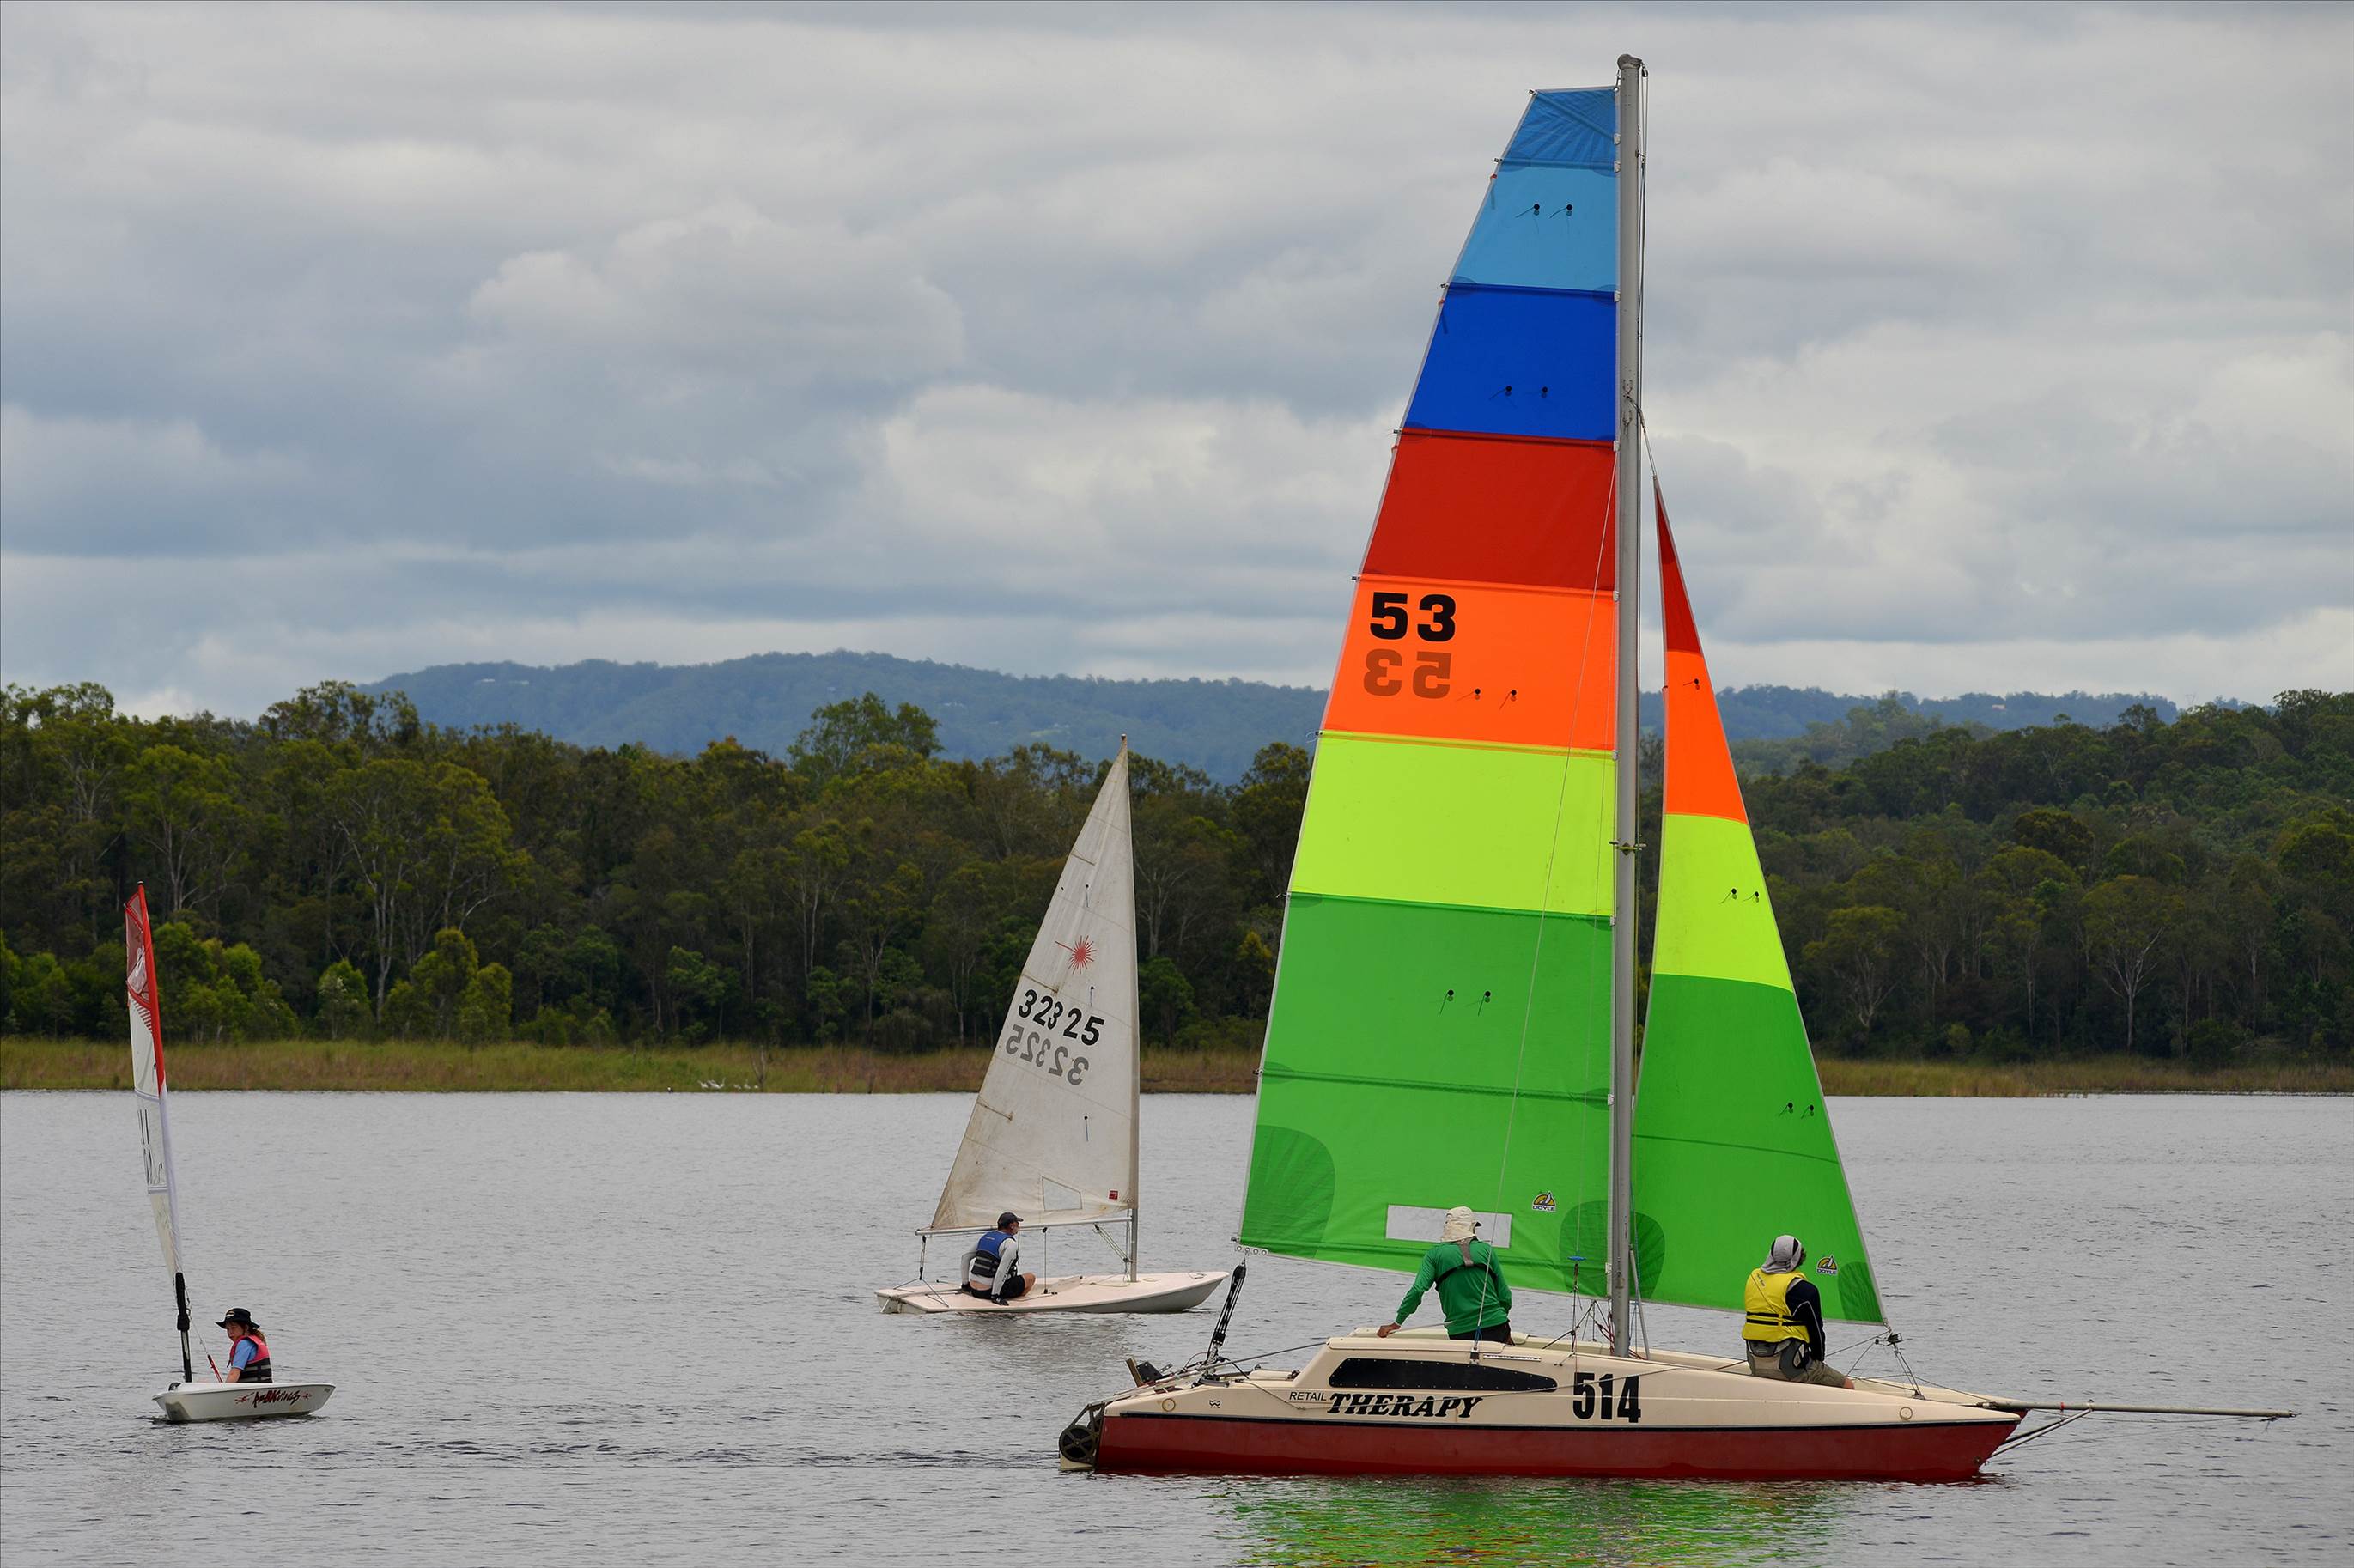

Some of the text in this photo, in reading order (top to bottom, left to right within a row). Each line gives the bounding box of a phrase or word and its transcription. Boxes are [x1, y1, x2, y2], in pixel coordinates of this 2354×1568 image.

[1370, 592, 1456, 641] 53
[1018, 989, 1105, 1046] 32325
[1289, 1391, 1483, 1418] RETAIL THERAPY
[1572, 1372, 1641, 1423] 514
